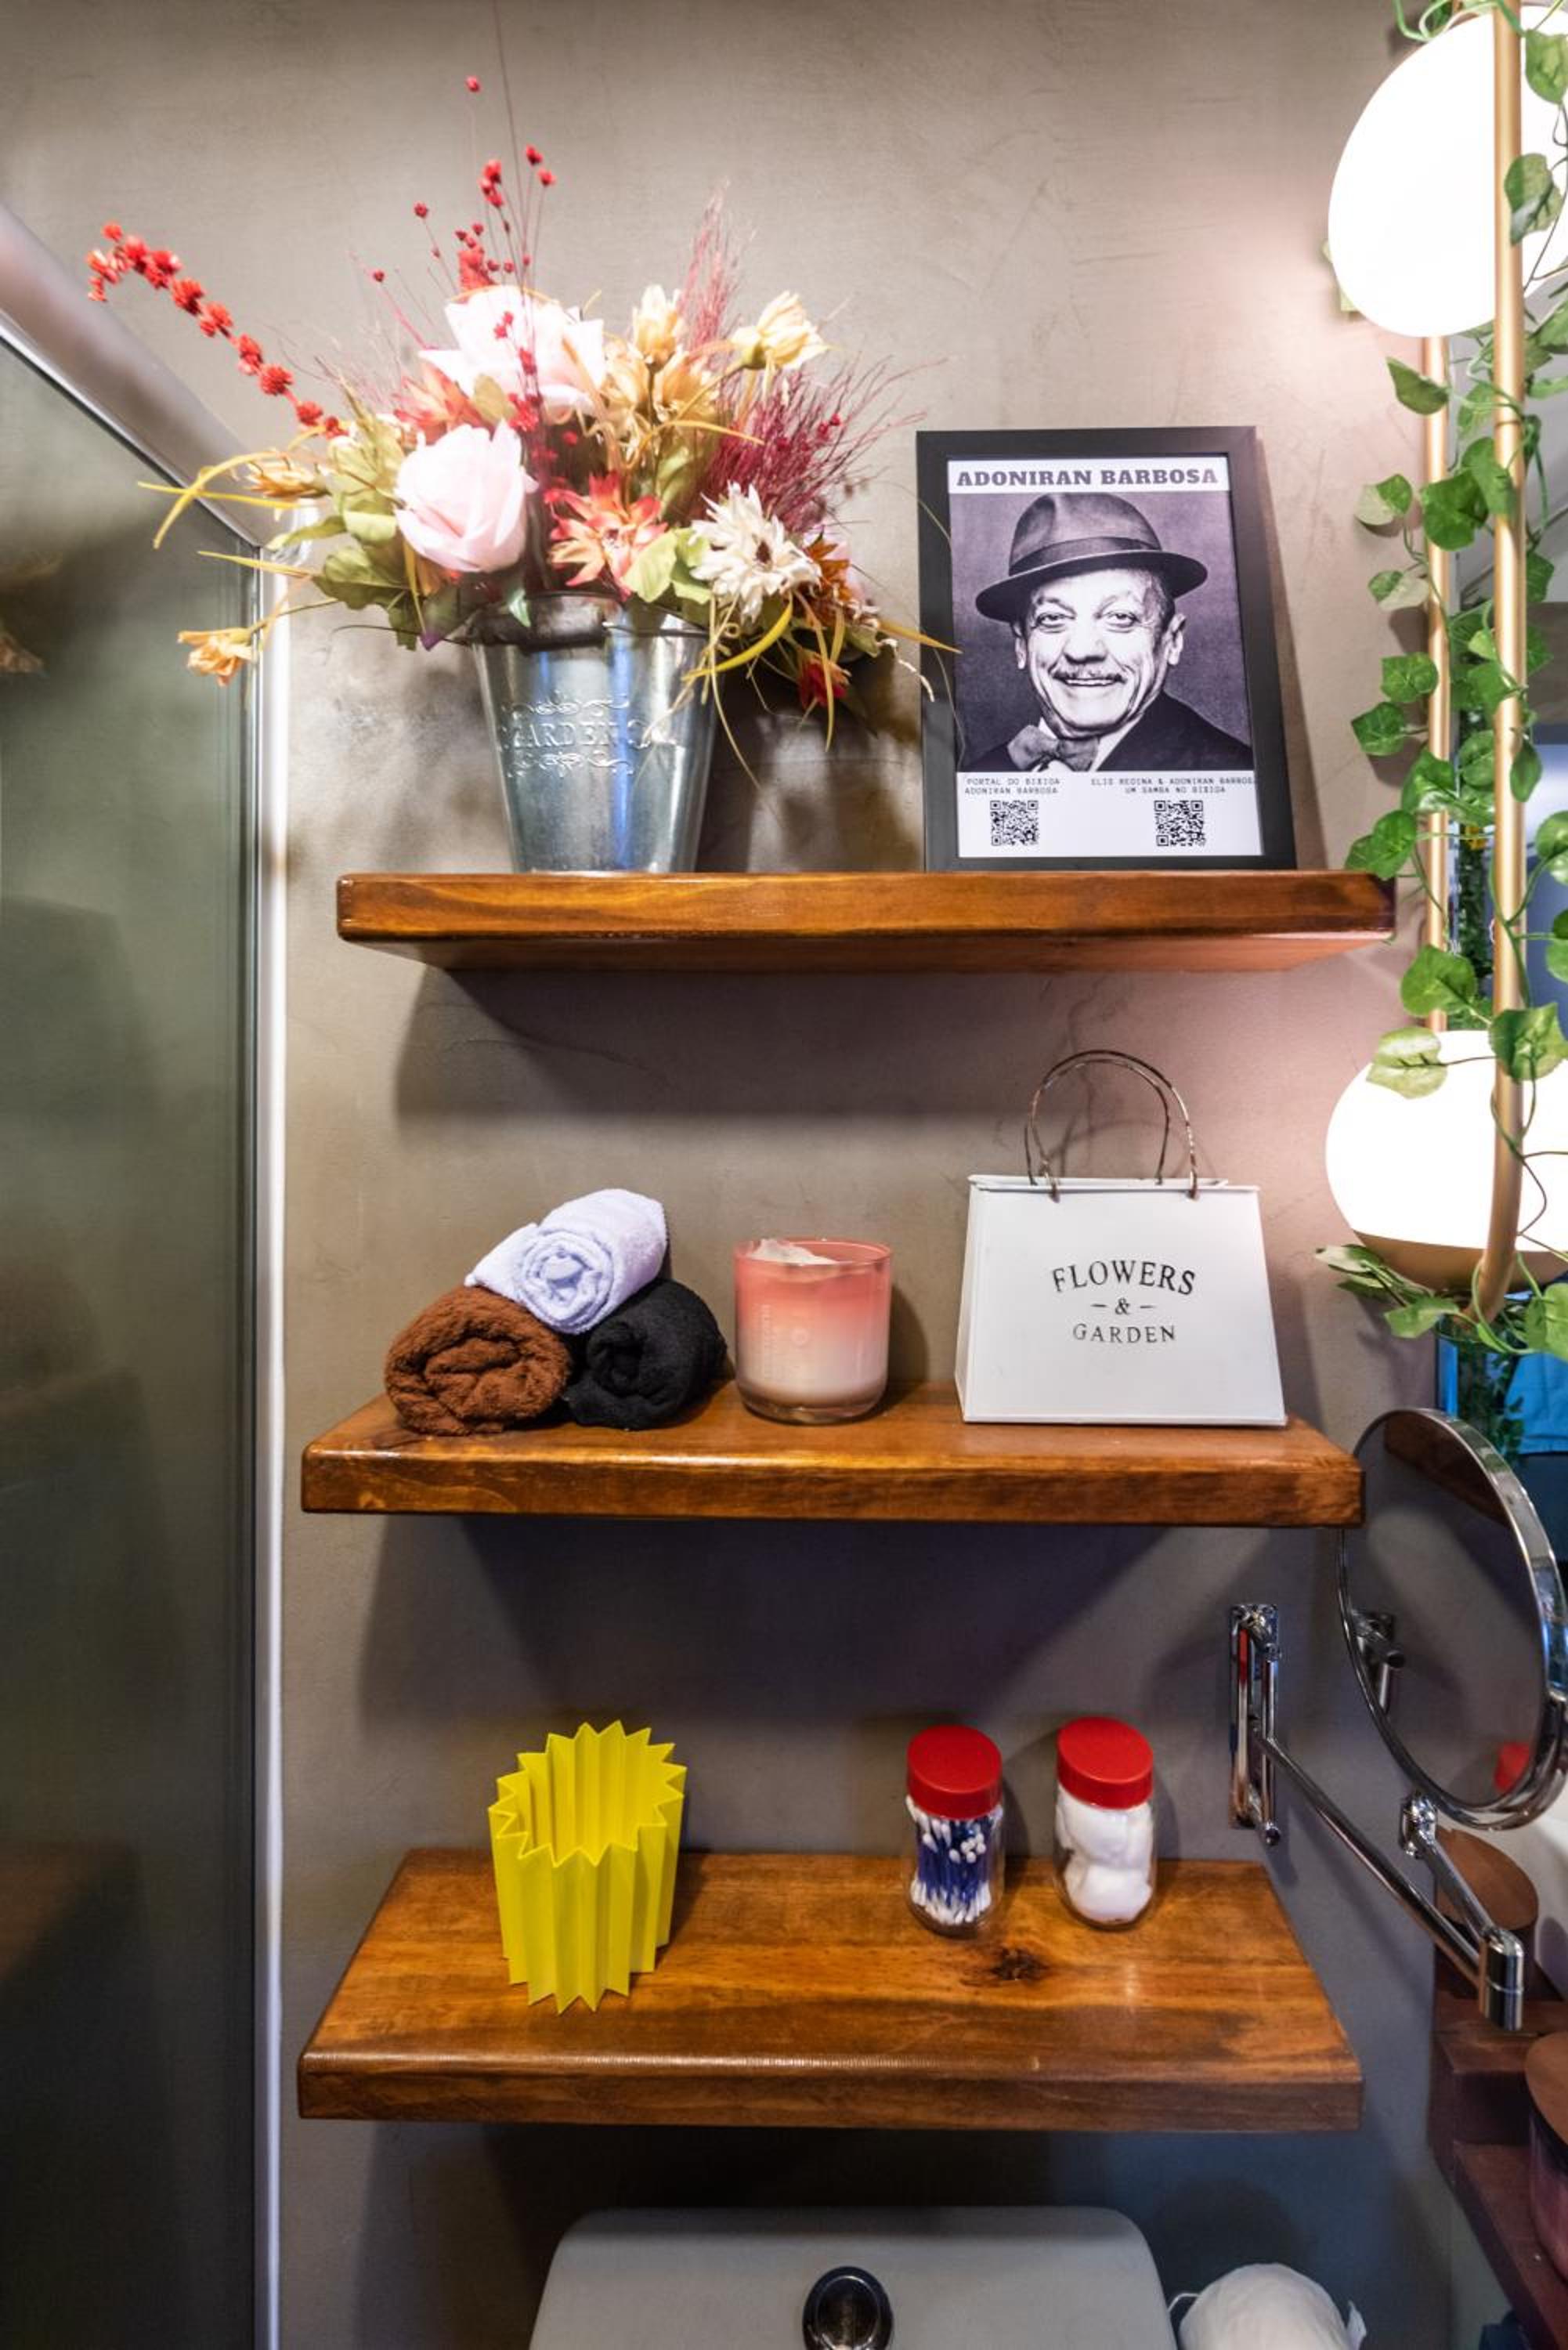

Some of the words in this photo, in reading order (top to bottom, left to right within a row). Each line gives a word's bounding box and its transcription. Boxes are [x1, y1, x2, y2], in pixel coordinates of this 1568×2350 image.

[956, 470, 1092, 486] ADONIRAN
[1100, 468, 1219, 485] BARBOSA
[1051, 1259, 1196, 1296] FLOWERS
[1115, 1296, 1131, 1316] &
[1072, 1323, 1176, 1344] GARDEN
